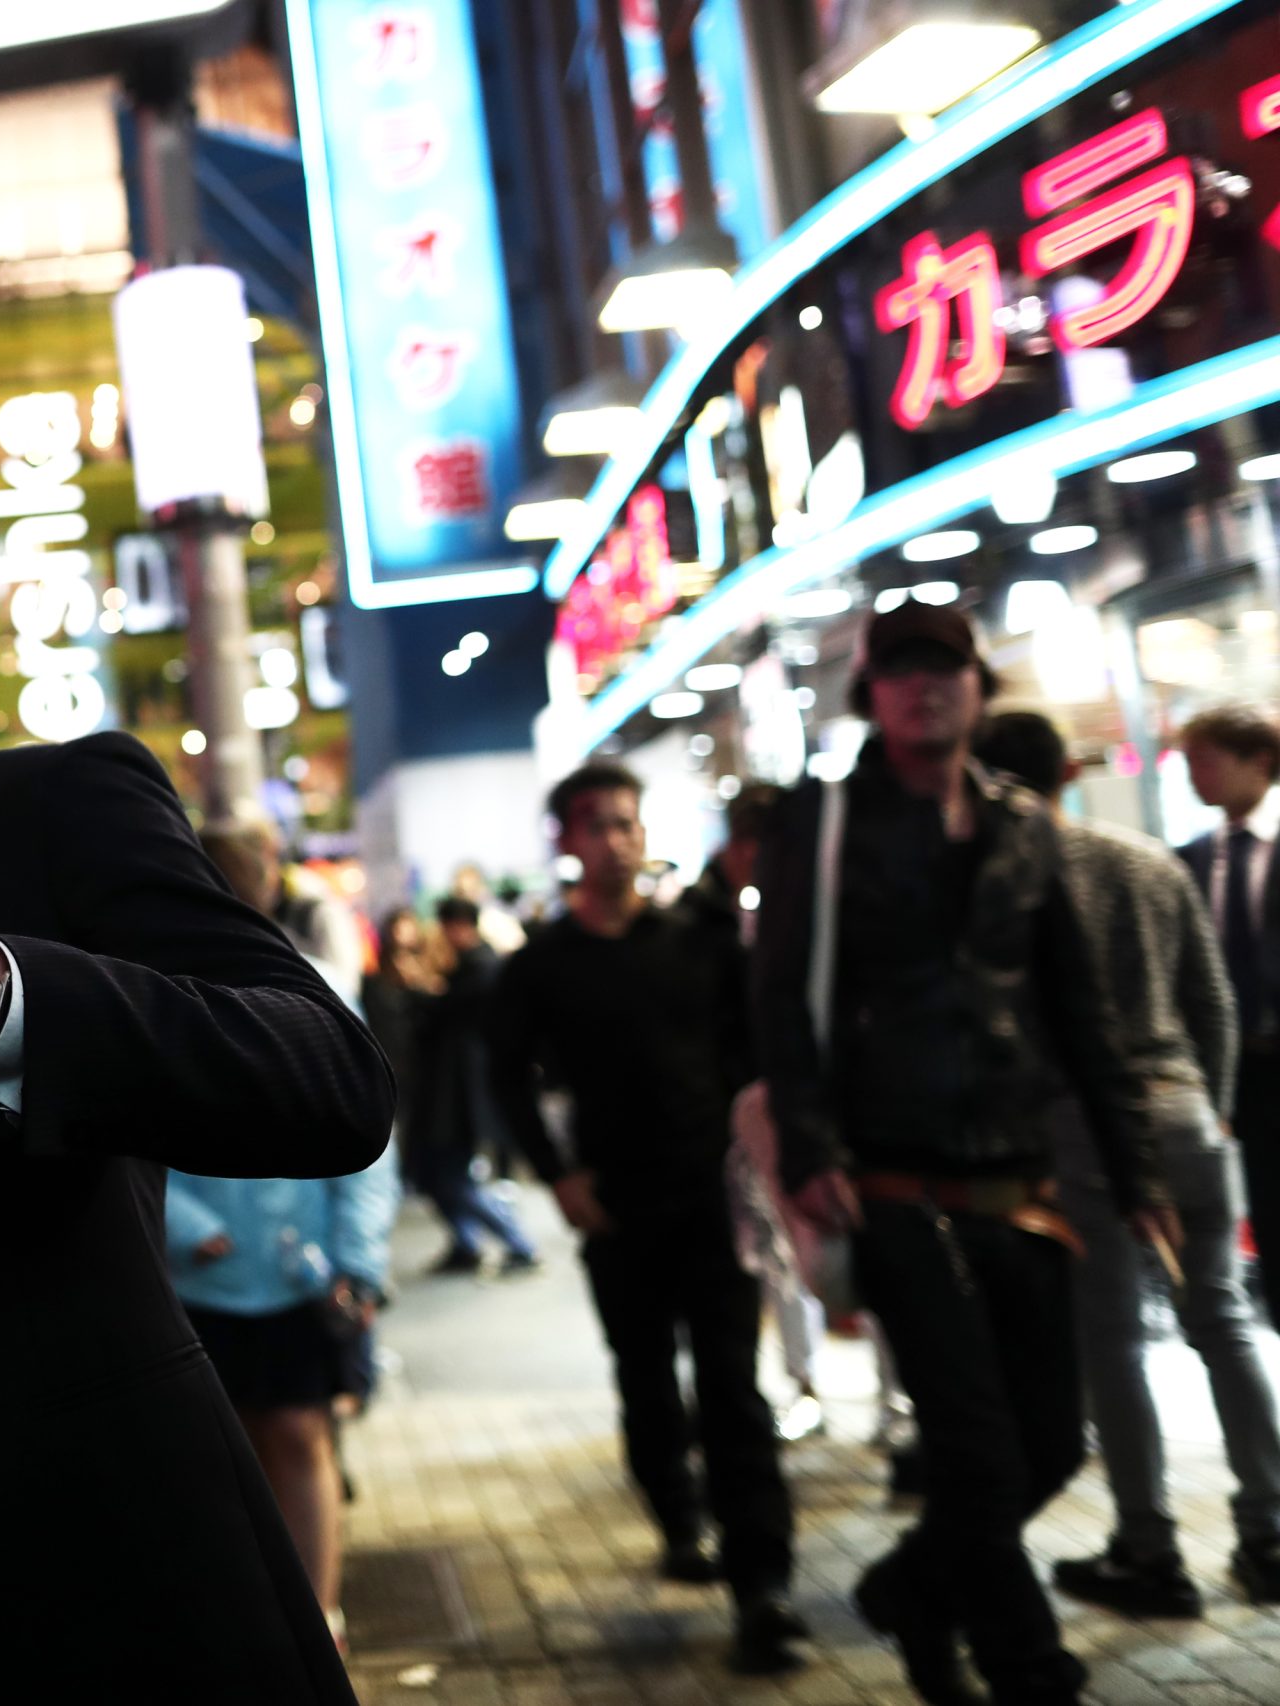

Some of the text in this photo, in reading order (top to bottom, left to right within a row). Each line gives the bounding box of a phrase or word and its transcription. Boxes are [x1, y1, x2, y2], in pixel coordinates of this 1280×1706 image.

[356, 8, 490, 520] カラオケ館
[874, 74, 1280, 431] カラ
